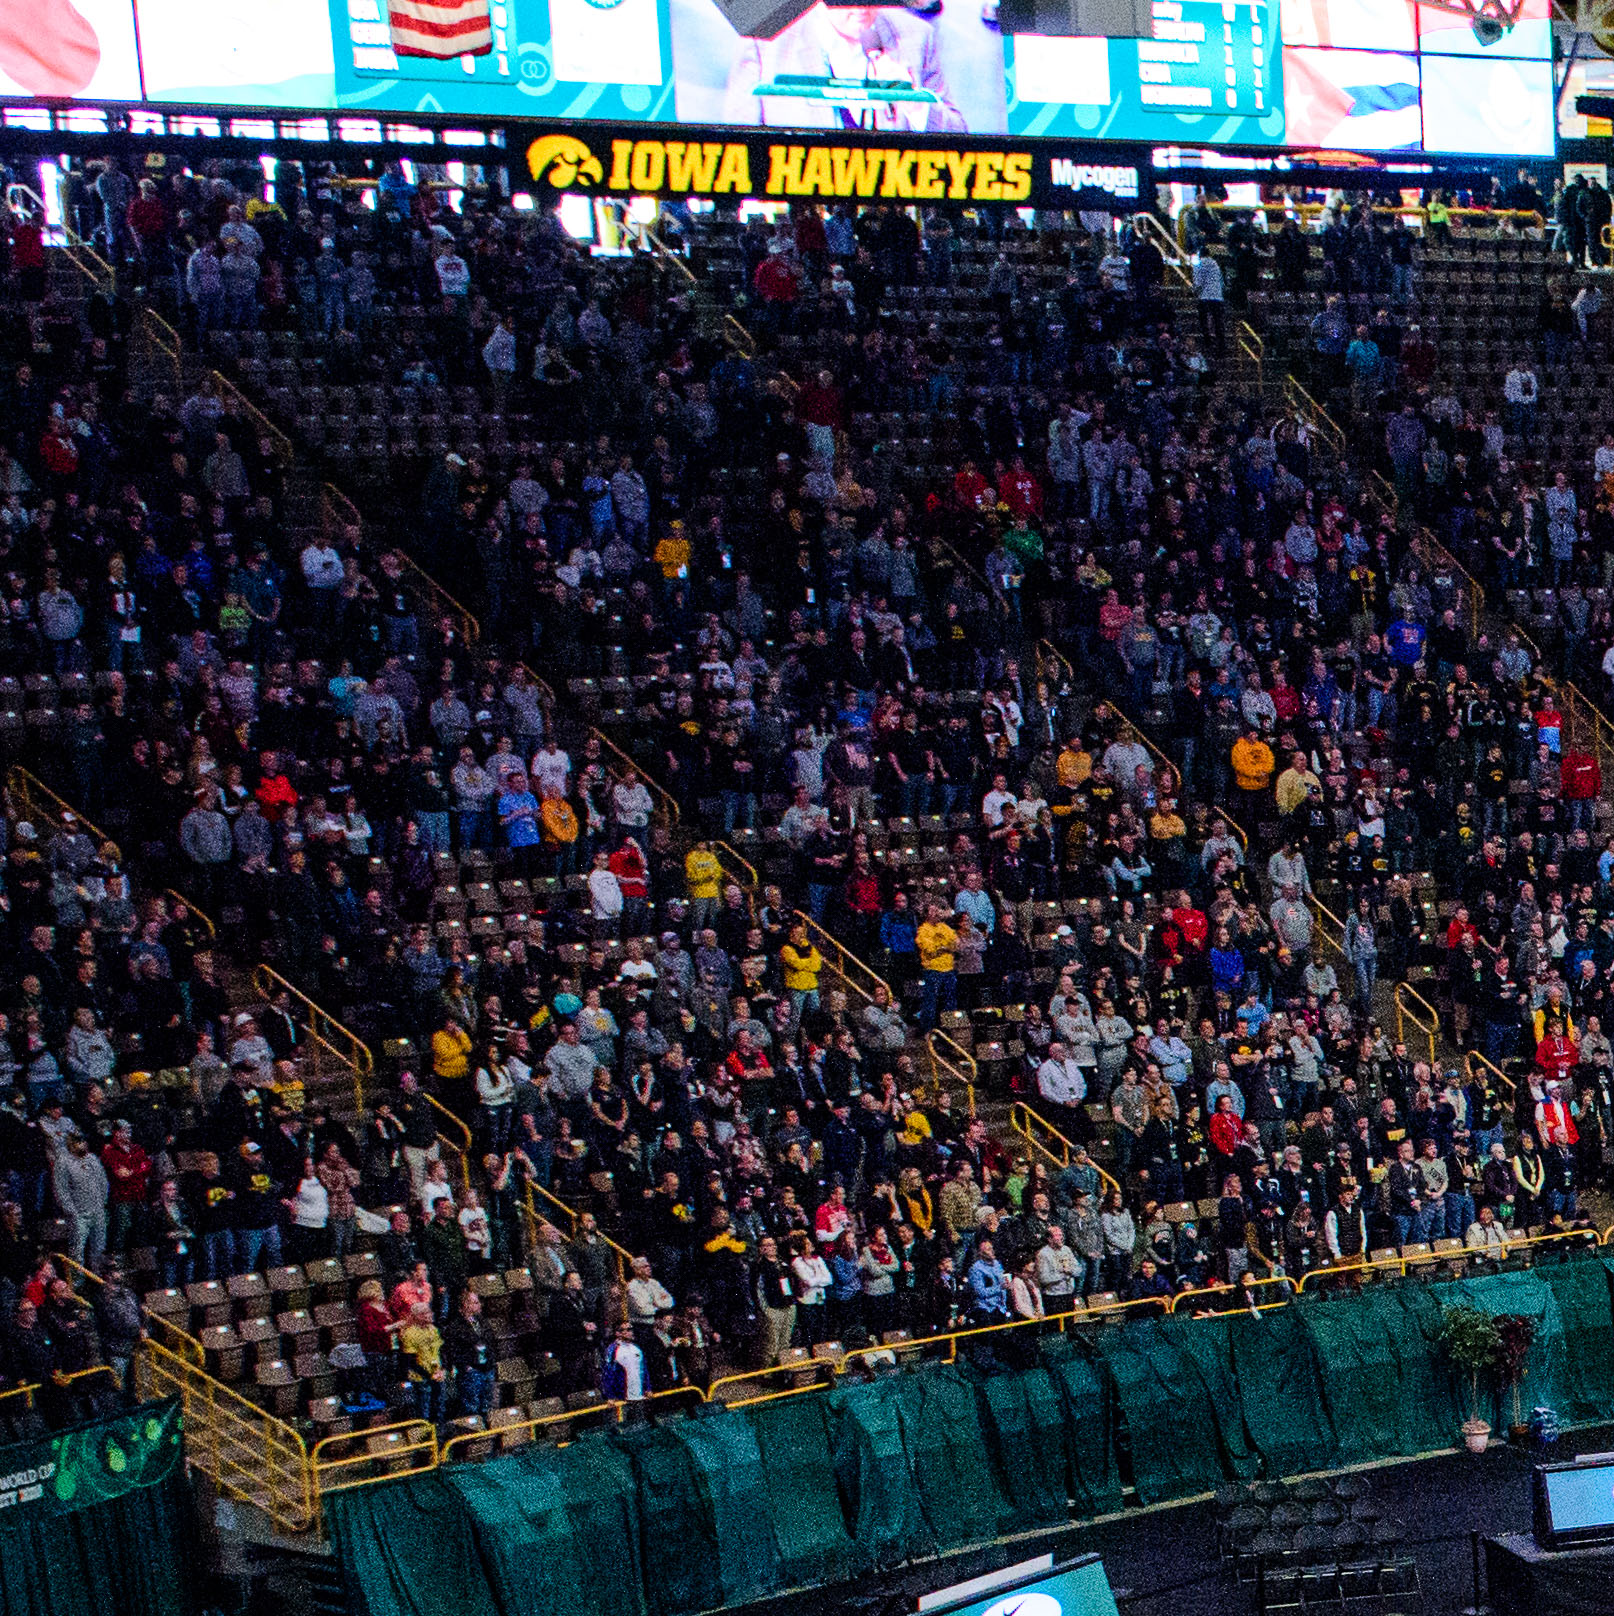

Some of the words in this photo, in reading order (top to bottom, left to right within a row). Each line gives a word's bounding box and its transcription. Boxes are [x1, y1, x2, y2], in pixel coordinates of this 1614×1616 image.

[609, 139, 752, 192] IOWA
[766, 145, 1032, 200] HAWKEYES
[1050, 158, 1138, 192] Mycogen
